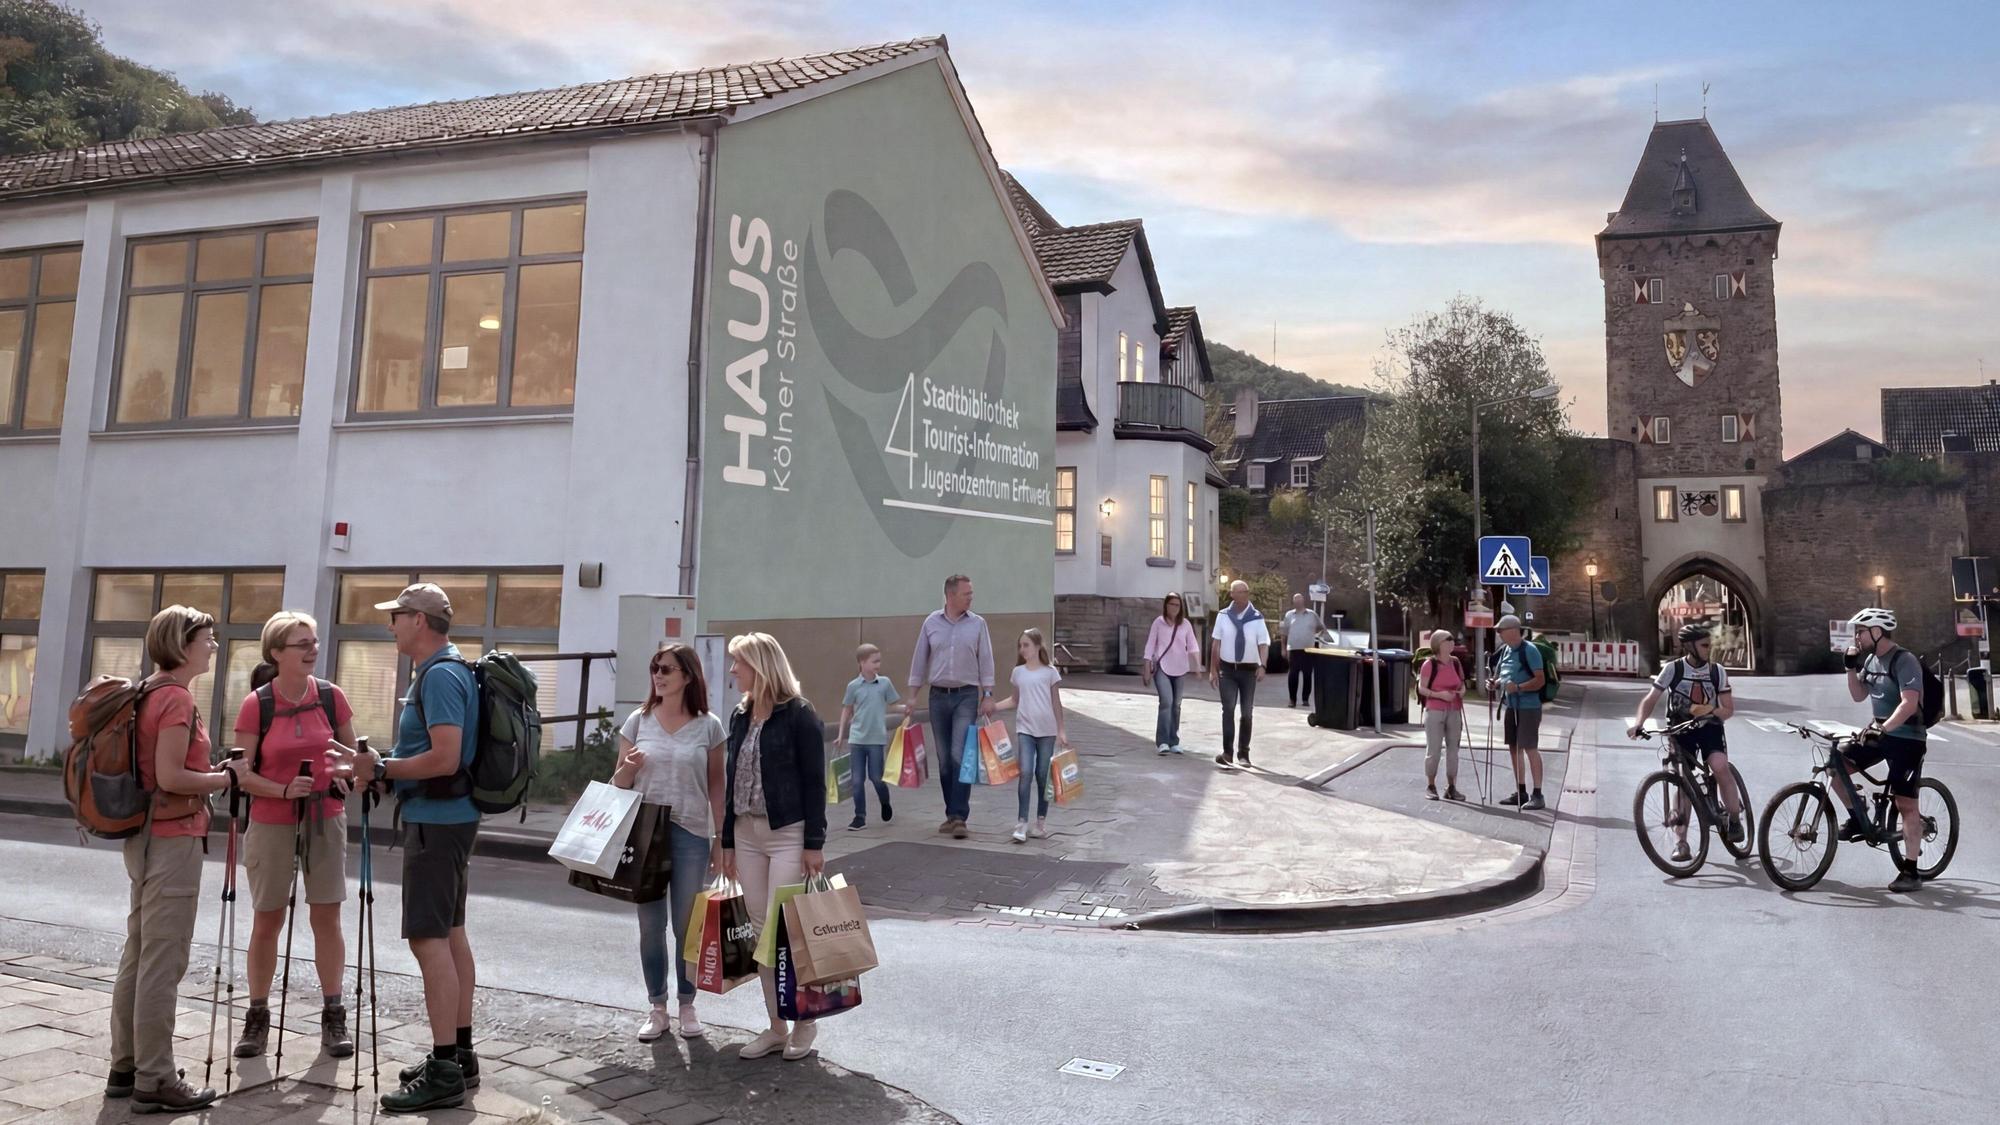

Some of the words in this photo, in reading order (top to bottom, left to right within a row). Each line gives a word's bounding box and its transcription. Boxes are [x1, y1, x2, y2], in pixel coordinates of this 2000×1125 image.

[723, 214, 773, 487] HAUS
[777, 239, 798, 361] Straße
[773, 372, 794, 492] Kölner
[885, 372, 918, 490] 4
[923, 377, 1019, 430] Stadtbibliothek
[923, 418, 1039, 470] Tourist-Information
[921, 462, 1010, 500] Jugendzentrum
[1012, 478, 1051, 507] Erftwerk
